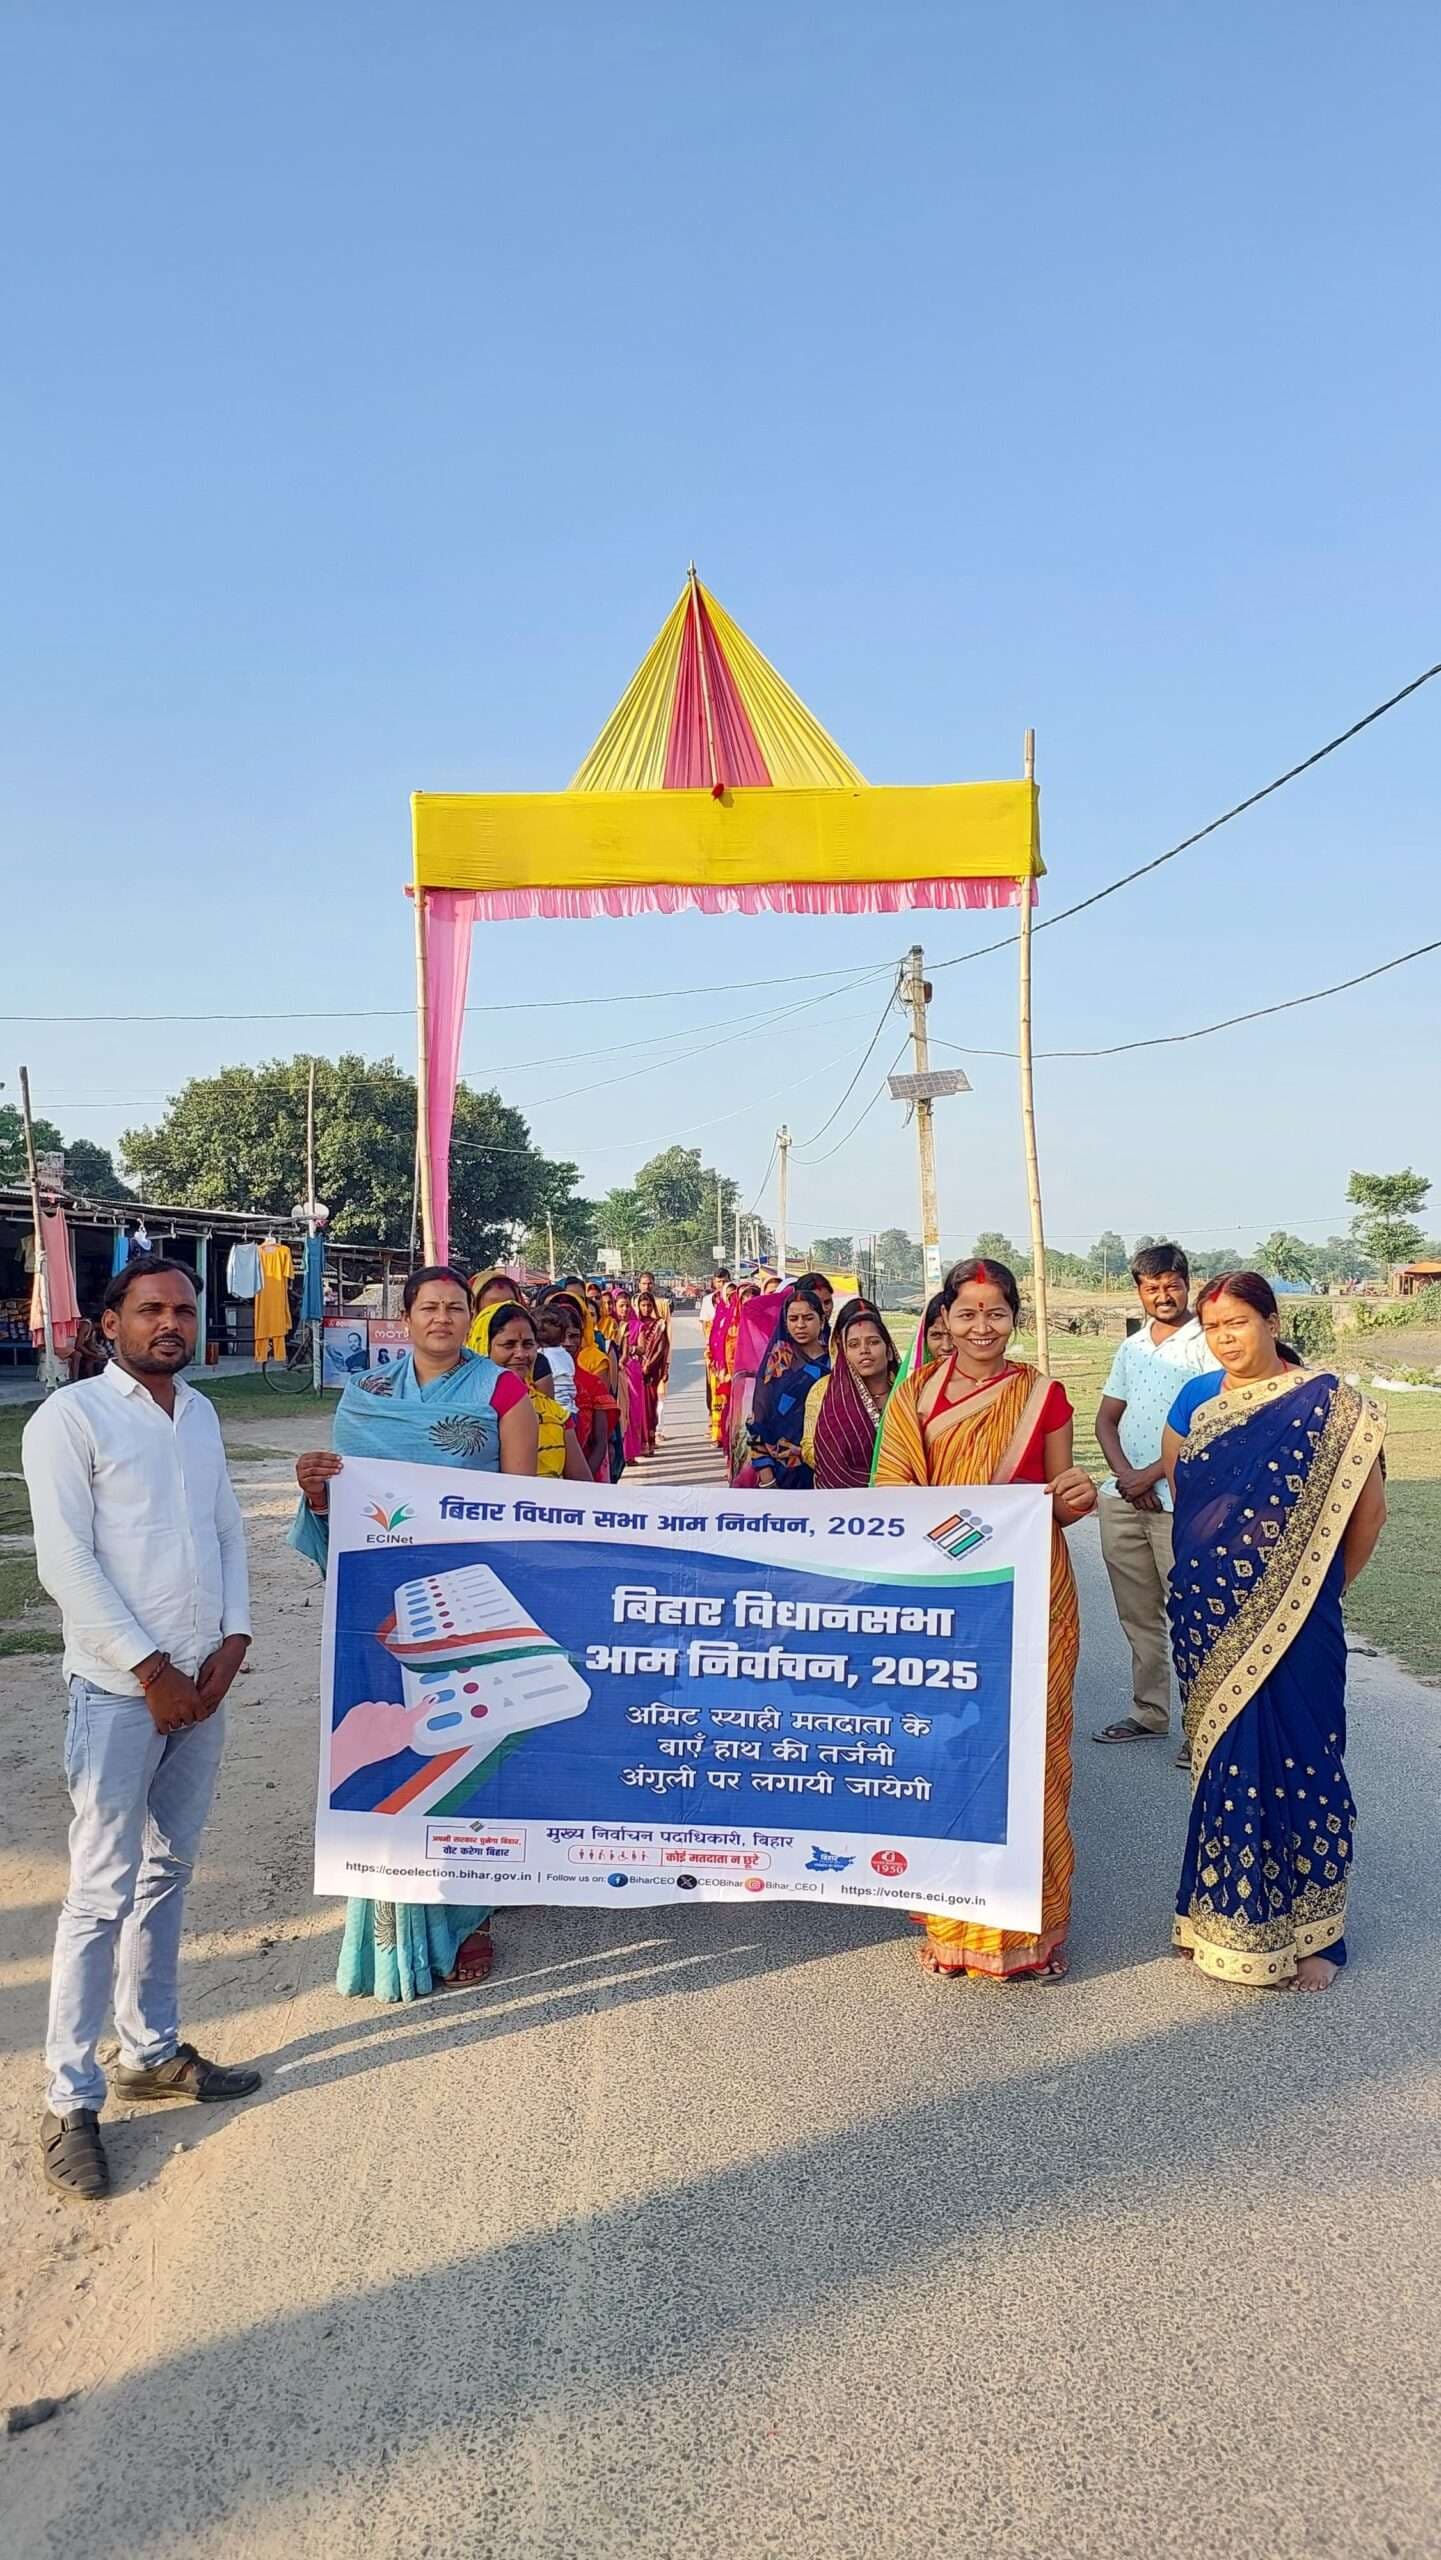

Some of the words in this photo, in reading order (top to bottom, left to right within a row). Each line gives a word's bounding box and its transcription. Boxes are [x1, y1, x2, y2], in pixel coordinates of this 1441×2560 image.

[439, 1495, 506, 1521] बिहार
[513, 1501, 585, 1526] विधान
[592, 1510, 648, 1530] सभा
[657, 1515, 708, 1532] आम
[716, 1512, 816, 1537] निर्वाचन,
[828, 1516, 905, 1537] 2025
[366, 1533, 413, 1545] ECINet
[611, 1585, 725, 1627] बिहार
[733, 1590, 955, 1637] विधानसभा
[585, 1644, 678, 1675] आम
[687, 1640, 858, 1688] निर्वाचन,
[871, 1656, 978, 1690] 2025
[625, 1702, 700, 1726] अमिट
[710, 1706, 781, 1730] स्याही
[792, 1711, 891, 1735] मतदाता
[901, 1712, 931, 1737] के
[657, 1731, 704, 1758] बाएँ
[713, 1739, 761, 1762] हाथ
[771, 1738, 808, 1763] की
[818, 1741, 895, 1767] तर्जनी
[620, 1763, 696, 1793] अंगुली
[707, 1770, 741, 1790] पर
[752, 1770, 834, 1794] लगायी
[845, 1774, 933, 1800] जायेगी
[546, 1826, 584, 1843] मुख्य
[592, 1825, 652, 1842] निर्वाचन
[660, 1829, 746, 1847] पदाधिकारी,
[753, 1833, 794, 1849] बिहार
[443, 1844, 457, 1854] वोट
[460, 1845, 483, 1855] करेगा
[486, 1846, 510, 1856] बिहार
[666, 1850, 686, 1863] कोई
[688, 1853, 728, 1865] मतदाता
[730, 1854, 740, 1865] न
[742, 1853, 760, 1868] छूटे
[345, 1861, 532, 1882] https://ceoelection.bihar.gov.in
[876, 1864, 904, 1874] 1950
[546, 1873, 576, 1882] Follow
[592, 1875, 606, 1883] on:
[629, 1875, 675, 1885] BiharCEO
[698, 1878, 743, 1888] CEOBihar
[765, 1881, 818, 1892] Bihar_CEO
[841, 1884, 987, 1906] https://voters.eci.gov.in
